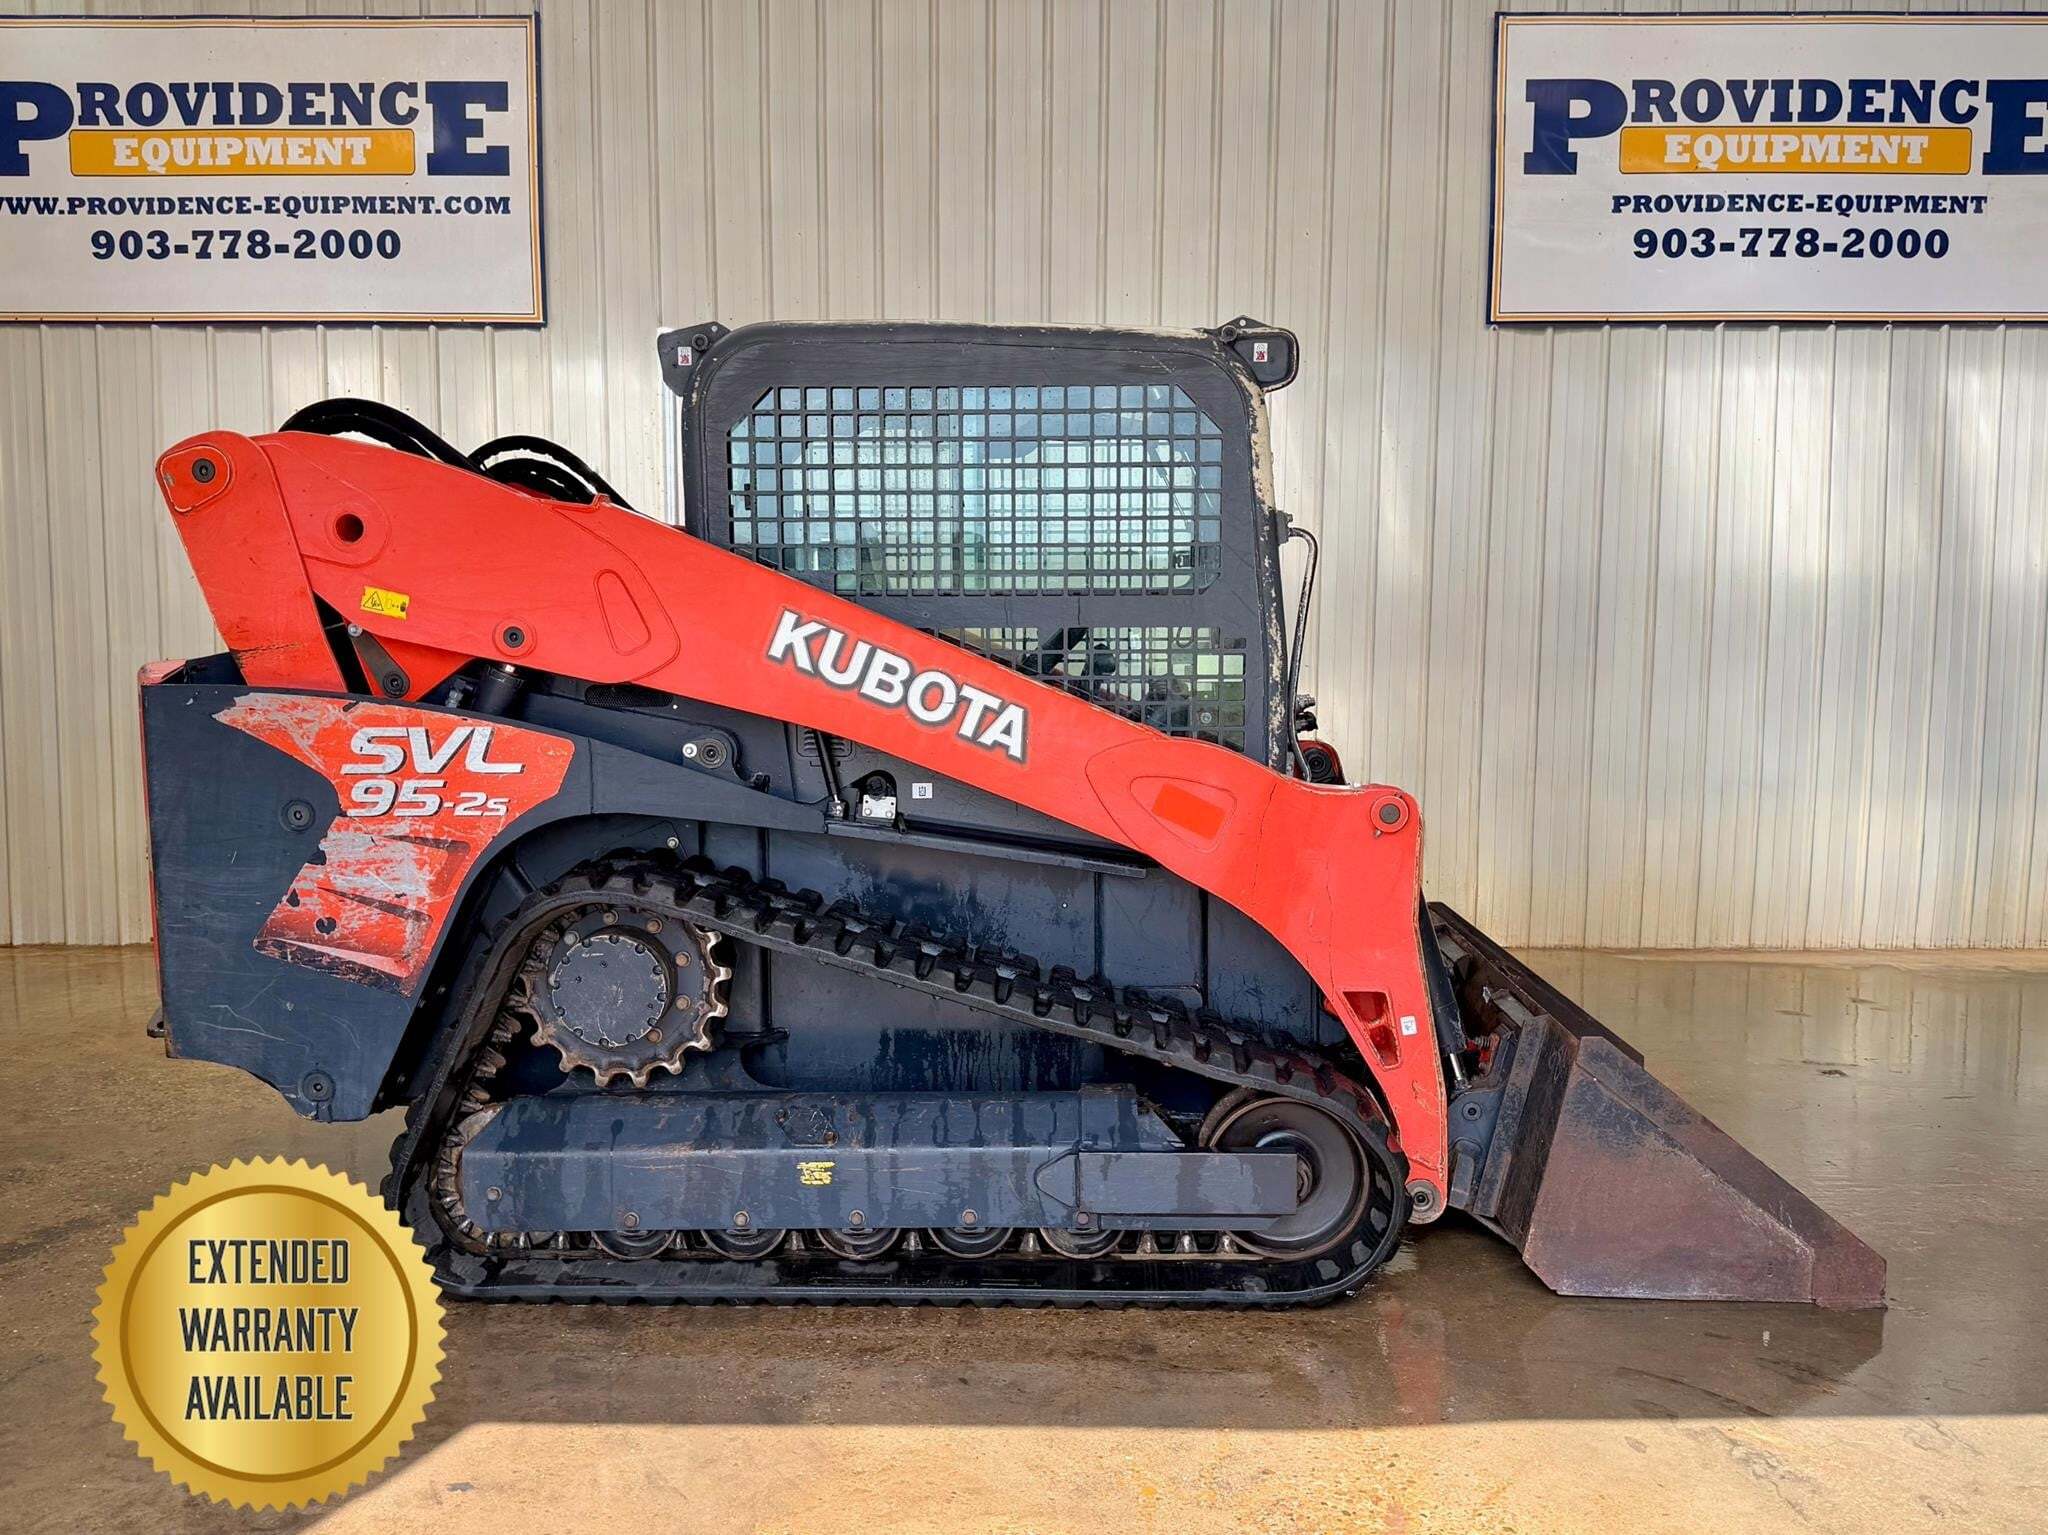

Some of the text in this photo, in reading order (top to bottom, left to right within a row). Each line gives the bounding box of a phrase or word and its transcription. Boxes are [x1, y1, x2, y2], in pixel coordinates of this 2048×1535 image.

[0, 81, 510, 177] PROVIDENCE
[1523, 78, 2048, 175] PROVIDENCE
[113, 137, 372, 174] EQUIPMENT
[1663, 135, 1929, 171] EQUIPMENT
[0, 196, 511, 219] WW.PROVIDENCE-EQUIPMENT.COM
[1611, 193, 1988, 217] PROVIDENCE-EQUIPMENT
[91, 229, 401, 260] 903-778-2000
[1633, 228, 1950, 259] 903-778-2000
[767, 609, 1026, 761] KUBOTA
[340, 726, 525, 775] SVL
